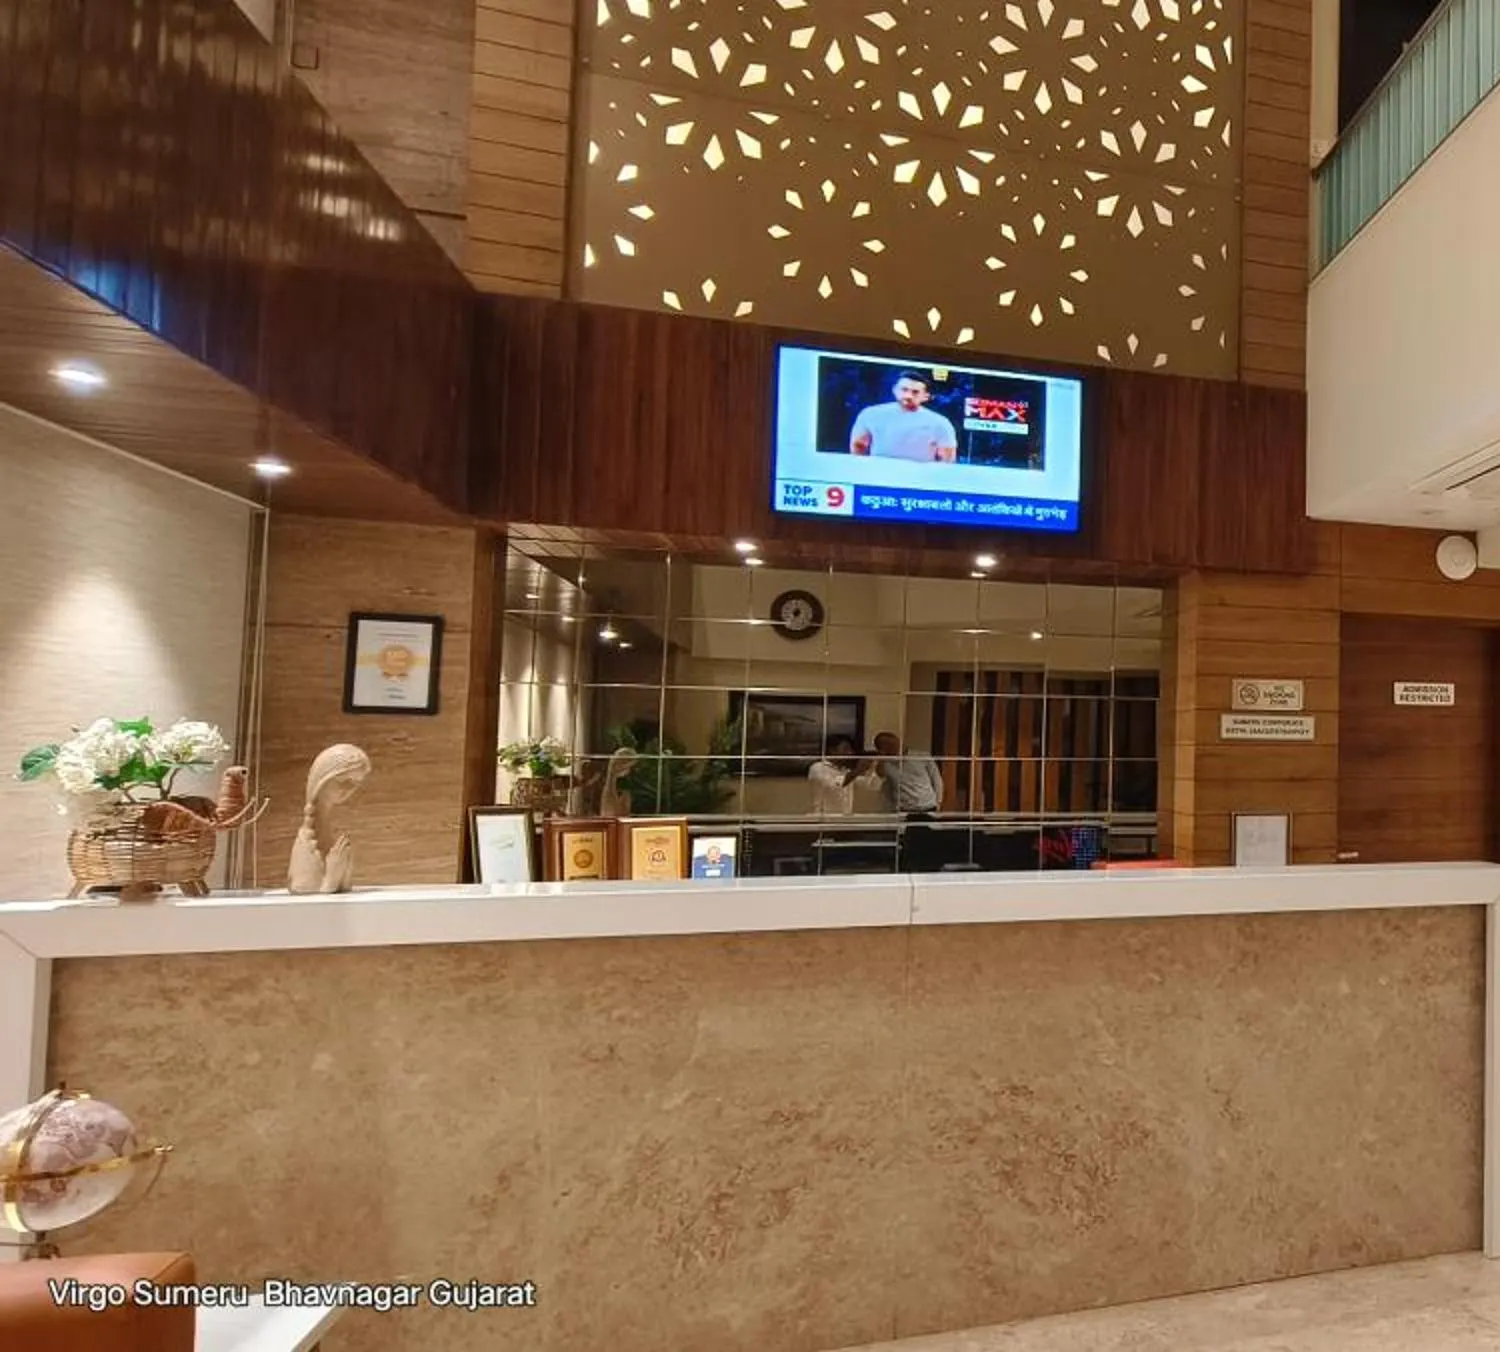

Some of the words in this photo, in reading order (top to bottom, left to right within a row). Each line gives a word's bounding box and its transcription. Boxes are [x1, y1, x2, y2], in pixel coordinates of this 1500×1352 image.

[964, 404, 1026, 421] MAX
[783, 484, 812, 496] TOP
[783, 495, 818, 507] NEWS
[826, 486, 845, 507] 9
[1399, 694, 1451, 702] RESTRICTED
